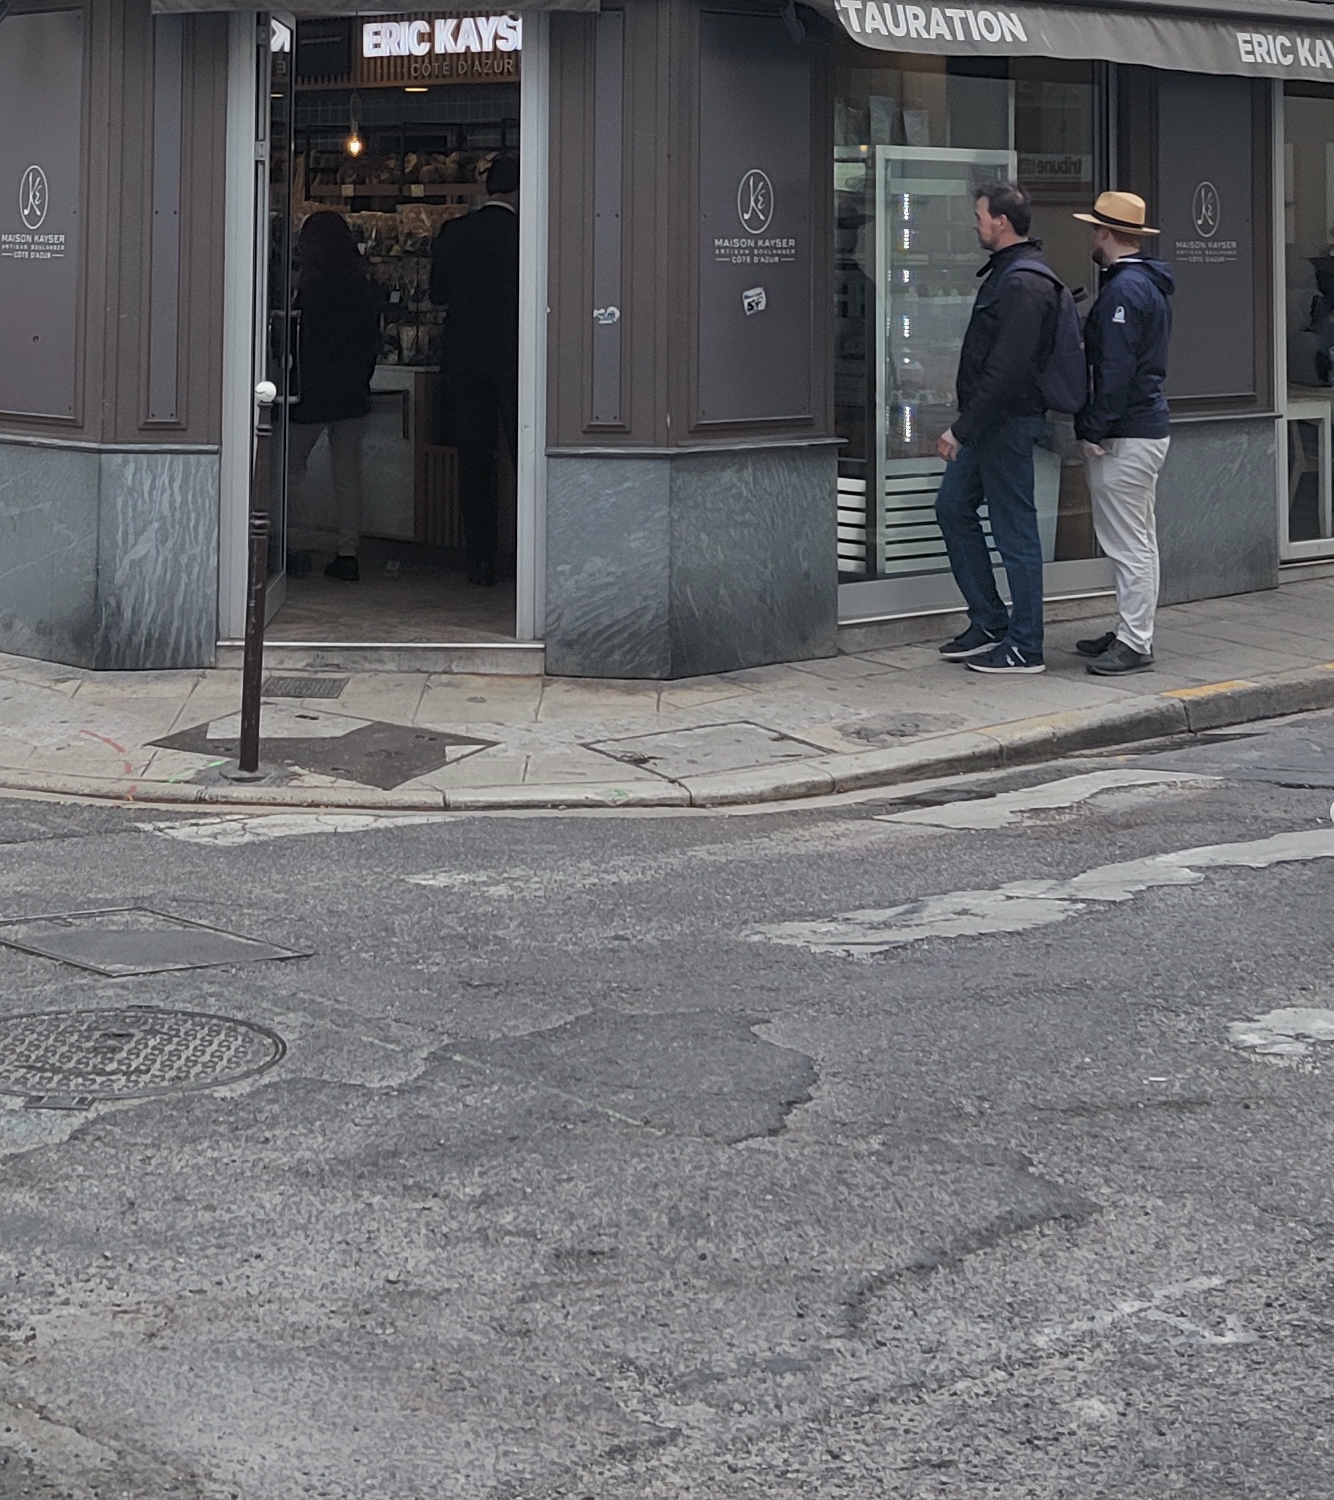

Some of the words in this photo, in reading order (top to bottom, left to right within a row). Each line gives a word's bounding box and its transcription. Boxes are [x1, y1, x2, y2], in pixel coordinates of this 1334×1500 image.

[834, 0, 1027, 42] TAURATION
[362, 19, 431, 58] ERIC
[434, 14, 523, 54] KAYS
[1236, 33, 1294, 66] ERIC
[458, 59, 514, 75] D'AZUR
[1, 234, 32, 243] MAISON
[33, 234, 65, 244] KAYSER
[714, 238, 755, 248] MAISON
[757, 238, 796, 248] KAYSER
[1175, 241, 1207, 249] MAISON
[1207, 241, 1237, 249] KAYSER
[731, 255, 751, 264] CÔTE
